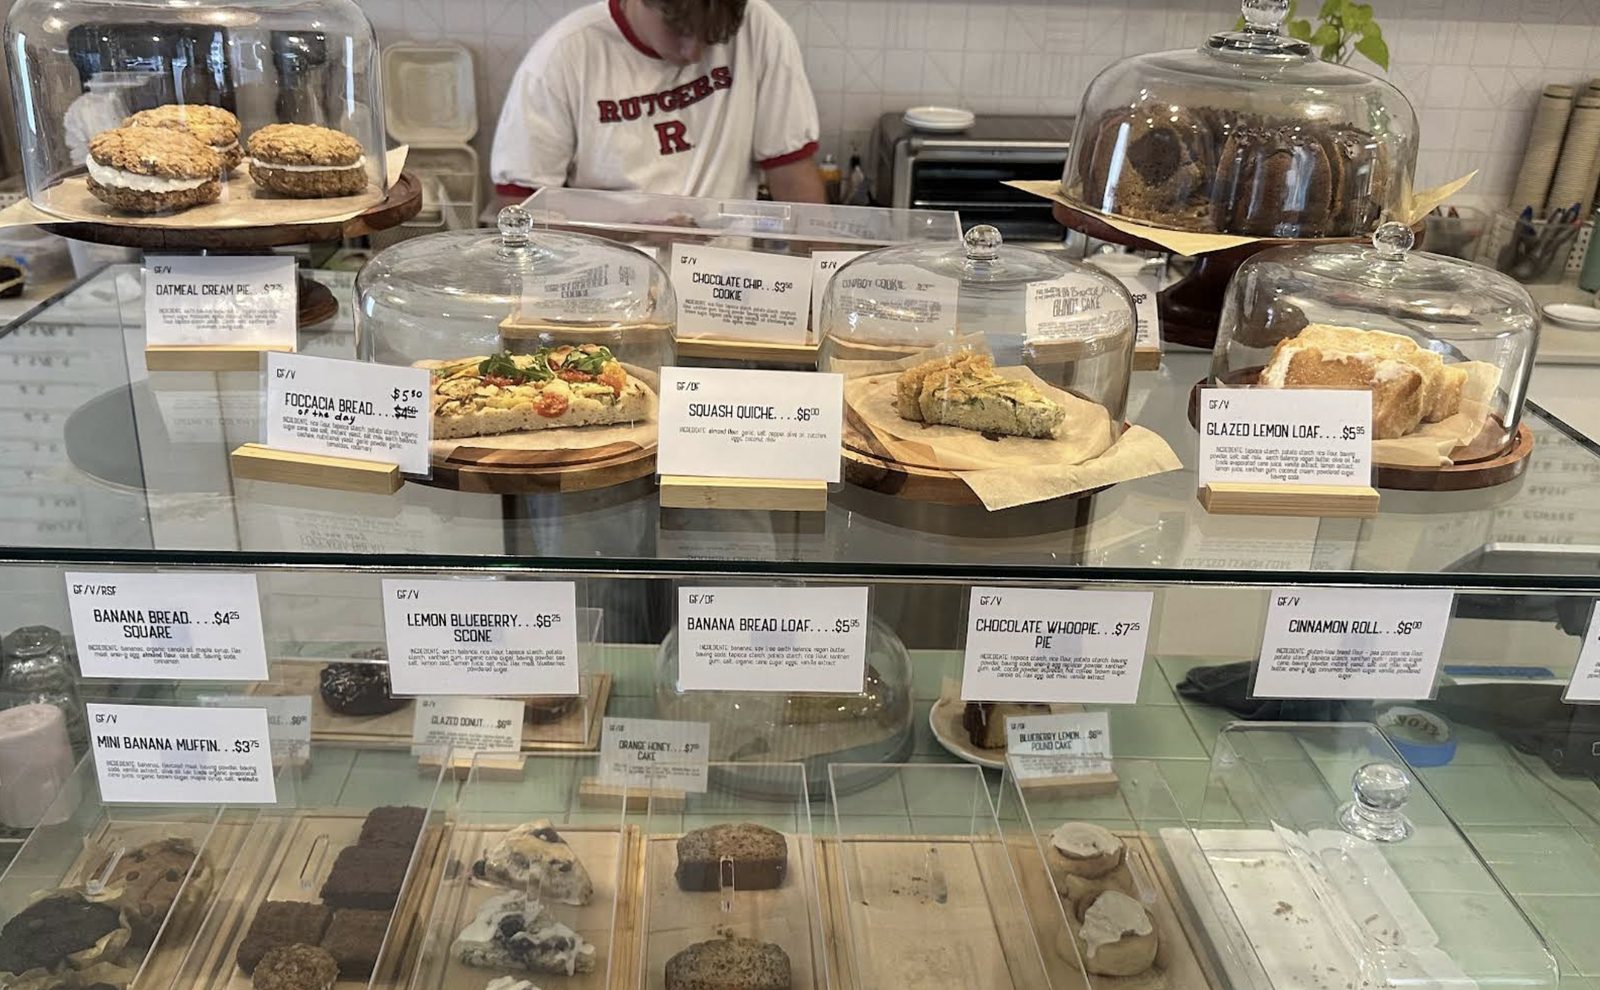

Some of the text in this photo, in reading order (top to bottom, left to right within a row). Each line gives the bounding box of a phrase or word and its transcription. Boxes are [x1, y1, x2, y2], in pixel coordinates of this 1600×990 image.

[597, 66, 733, 123] RUTGERS
[654, 120, 691, 155] R
[692, 272, 741, 288] CHOCOLATE
[156, 284, 198, 296] OATMEAL
[202, 284, 233, 296] CREAM
[713, 288, 742, 301] COOKIE
[285, 392, 335, 411] FOCCACIA
[688, 403, 733, 418] SQUASH
[312, 410, 329, 418] the
[335, 412, 356, 425] day
[1206, 422, 1249, 437] GLAZED
[1253, 424, 1289, 438] LEMON
[73, 585, 117, 596] GF/V/RSF
[397, 590, 419, 599] GF/V
[689, 594, 715, 604] GF/DF
[980, 596, 1002, 606] GF/V
[1278, 597, 1300, 606] GF/V
[93, 609, 145, 623] BANANA
[407, 613, 446, 627] LEMON
[687, 617, 735, 631] BANANA
[739, 618, 777, 632] BREAD
[976, 619, 1042, 633] CHOCOLATE
[1288, 620, 1348, 634] CINNAMON
[124, 626, 172, 639] SQUARE
[454, 629, 492, 642] SCONE
[1035, 636, 1052, 648] PIE
[95, 714, 117, 724] GF/V
[97, 736, 120, 749] MINI
[124, 736, 172, 750] BANANA
[1054, 741, 1072, 750] CAKE
[637, 751, 656, 761] CAKE
